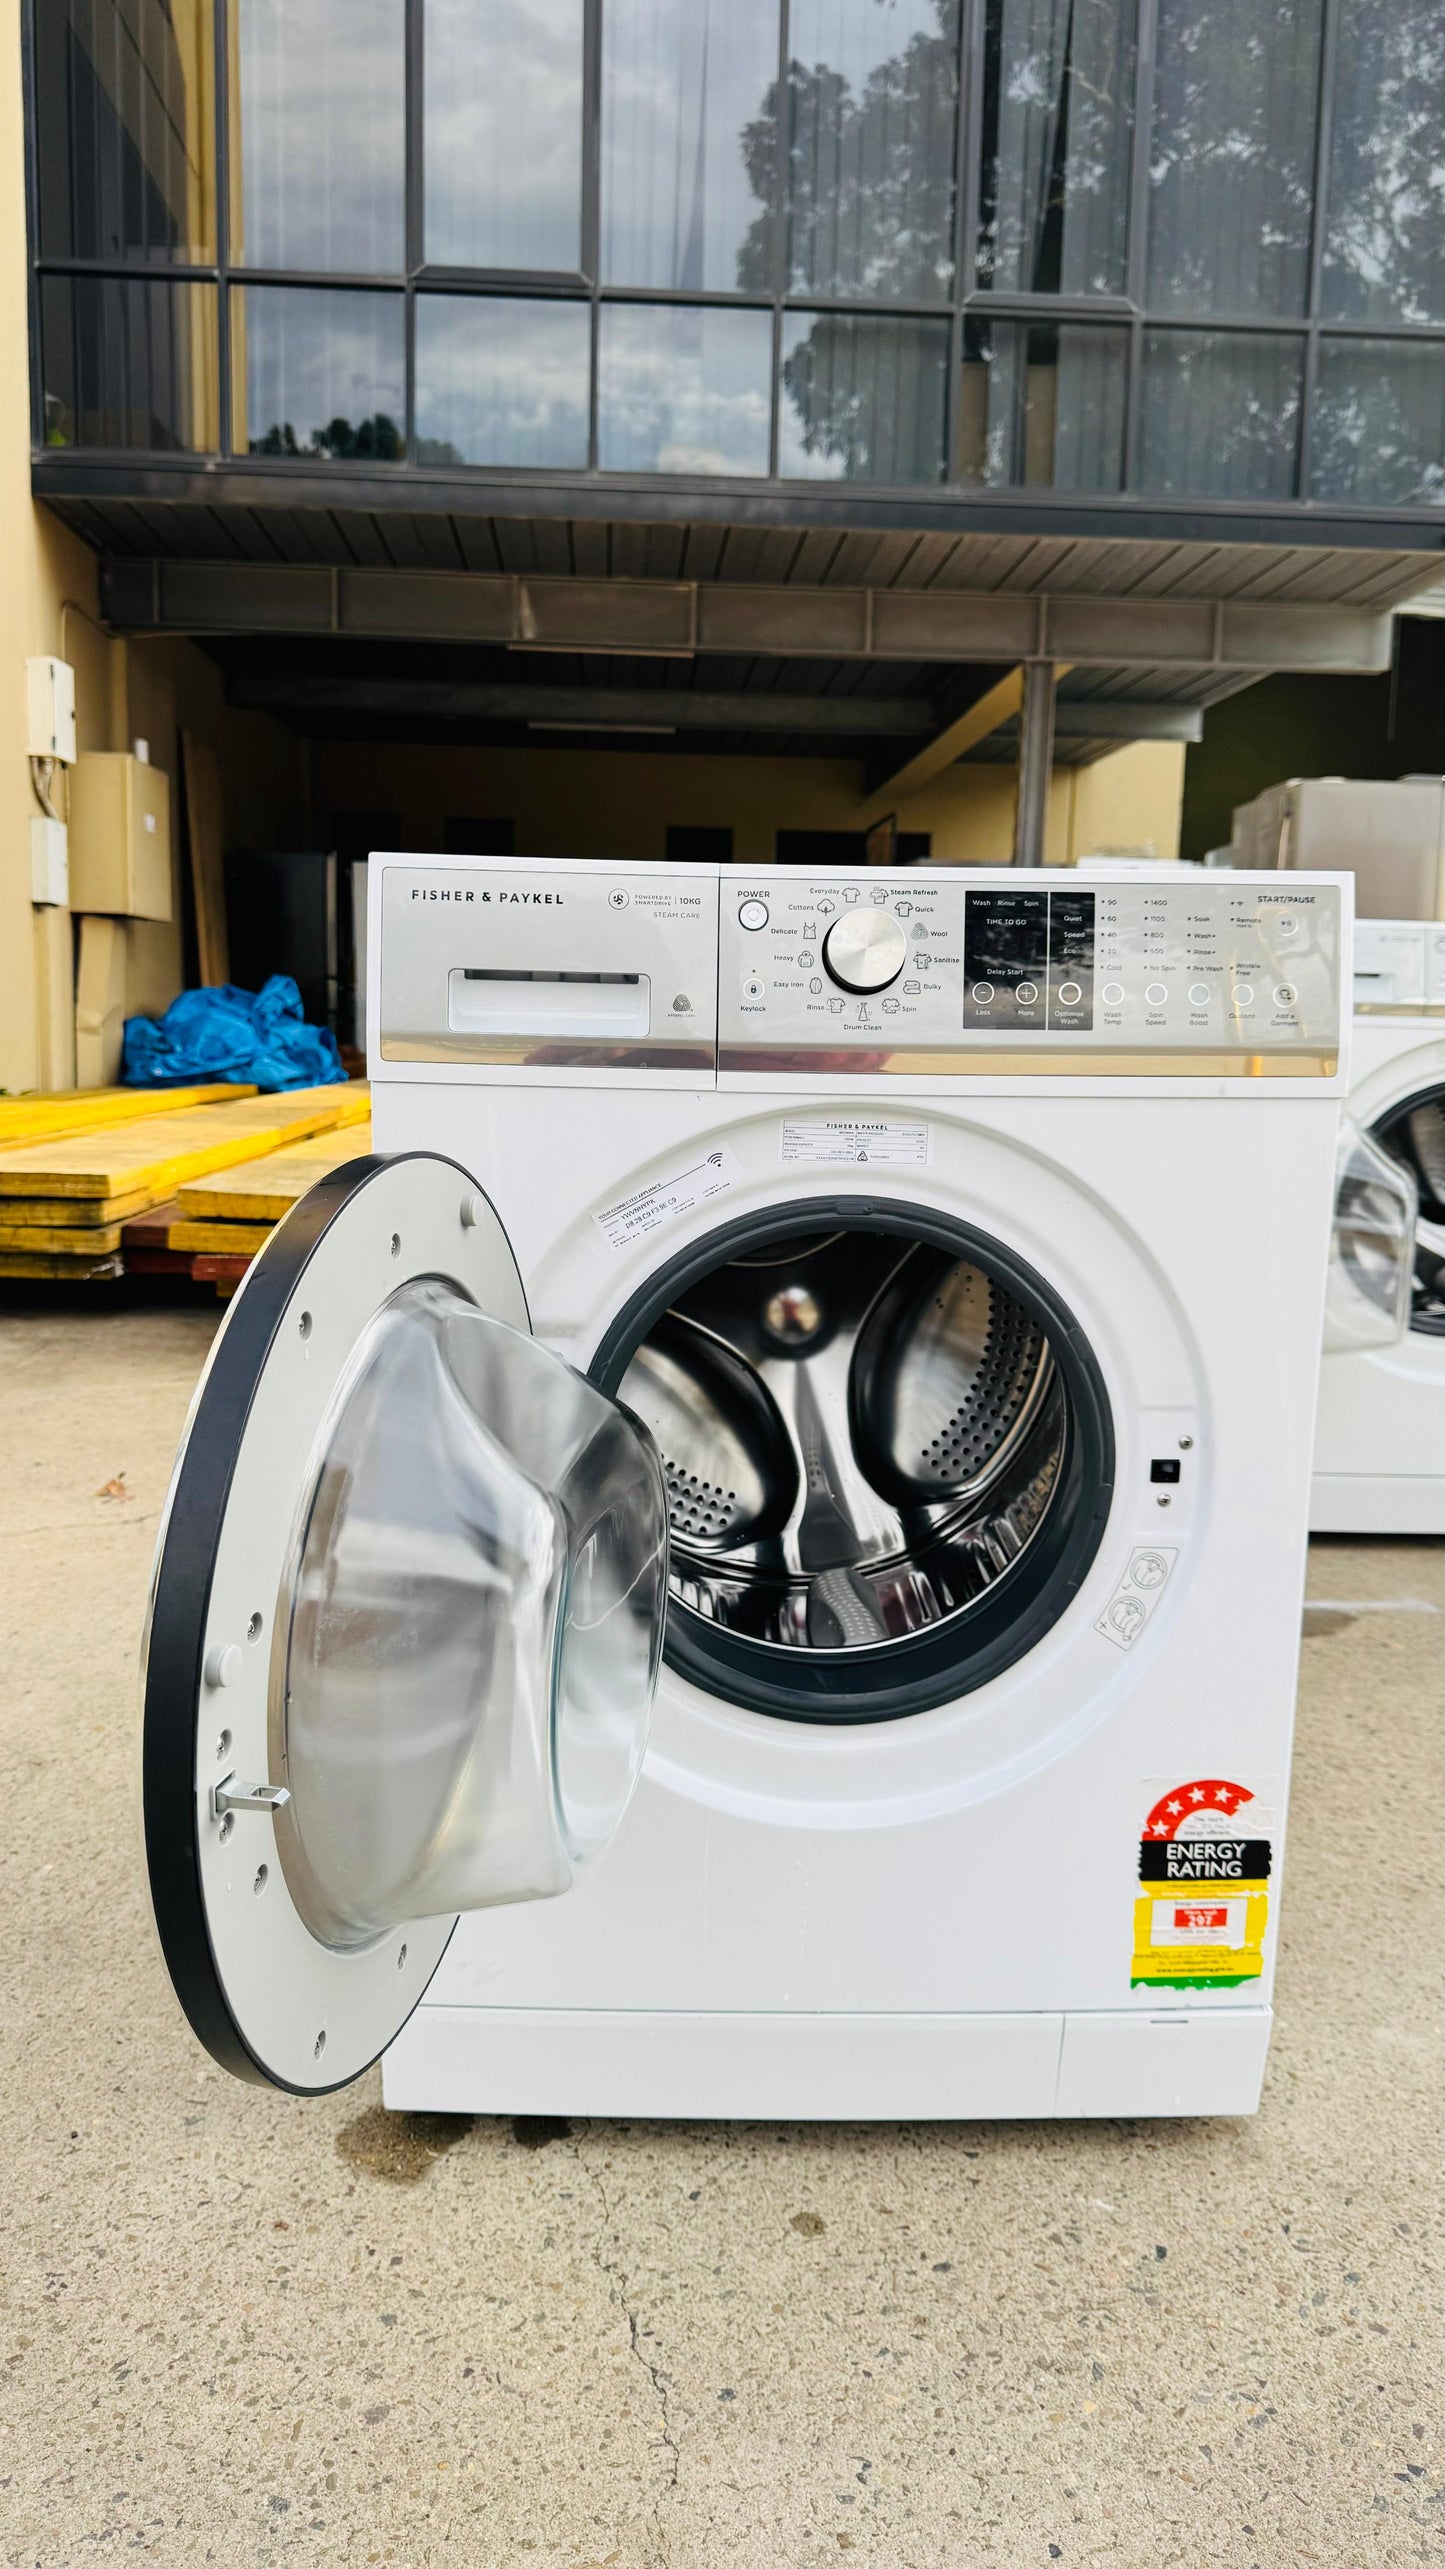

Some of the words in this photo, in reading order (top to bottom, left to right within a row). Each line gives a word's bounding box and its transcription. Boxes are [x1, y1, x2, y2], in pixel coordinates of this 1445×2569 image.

[738, 890, 770, 898] POWER
[809, 887, 840, 895] Everyday
[411, 889, 474, 902] FISHER
[482, 891, 491, 902] &
[499, 892, 564, 904] PAYKEL
[1257, 895, 1316, 904] START/PAUSE
[680, 897, 701, 905] 10KG
[997, 899, 1016, 907] Rinse
[987, 968, 1006, 976] Delay
[923, 983, 942, 991] Bulky
[625, 1220, 635, 1229] D8
[642, 1211, 652, 1220] C9
[667, 1197, 677, 1206] C9
[1166, 1842, 1247, 1860] ENERGY
[1167, 1860, 1243, 1878] RATING
